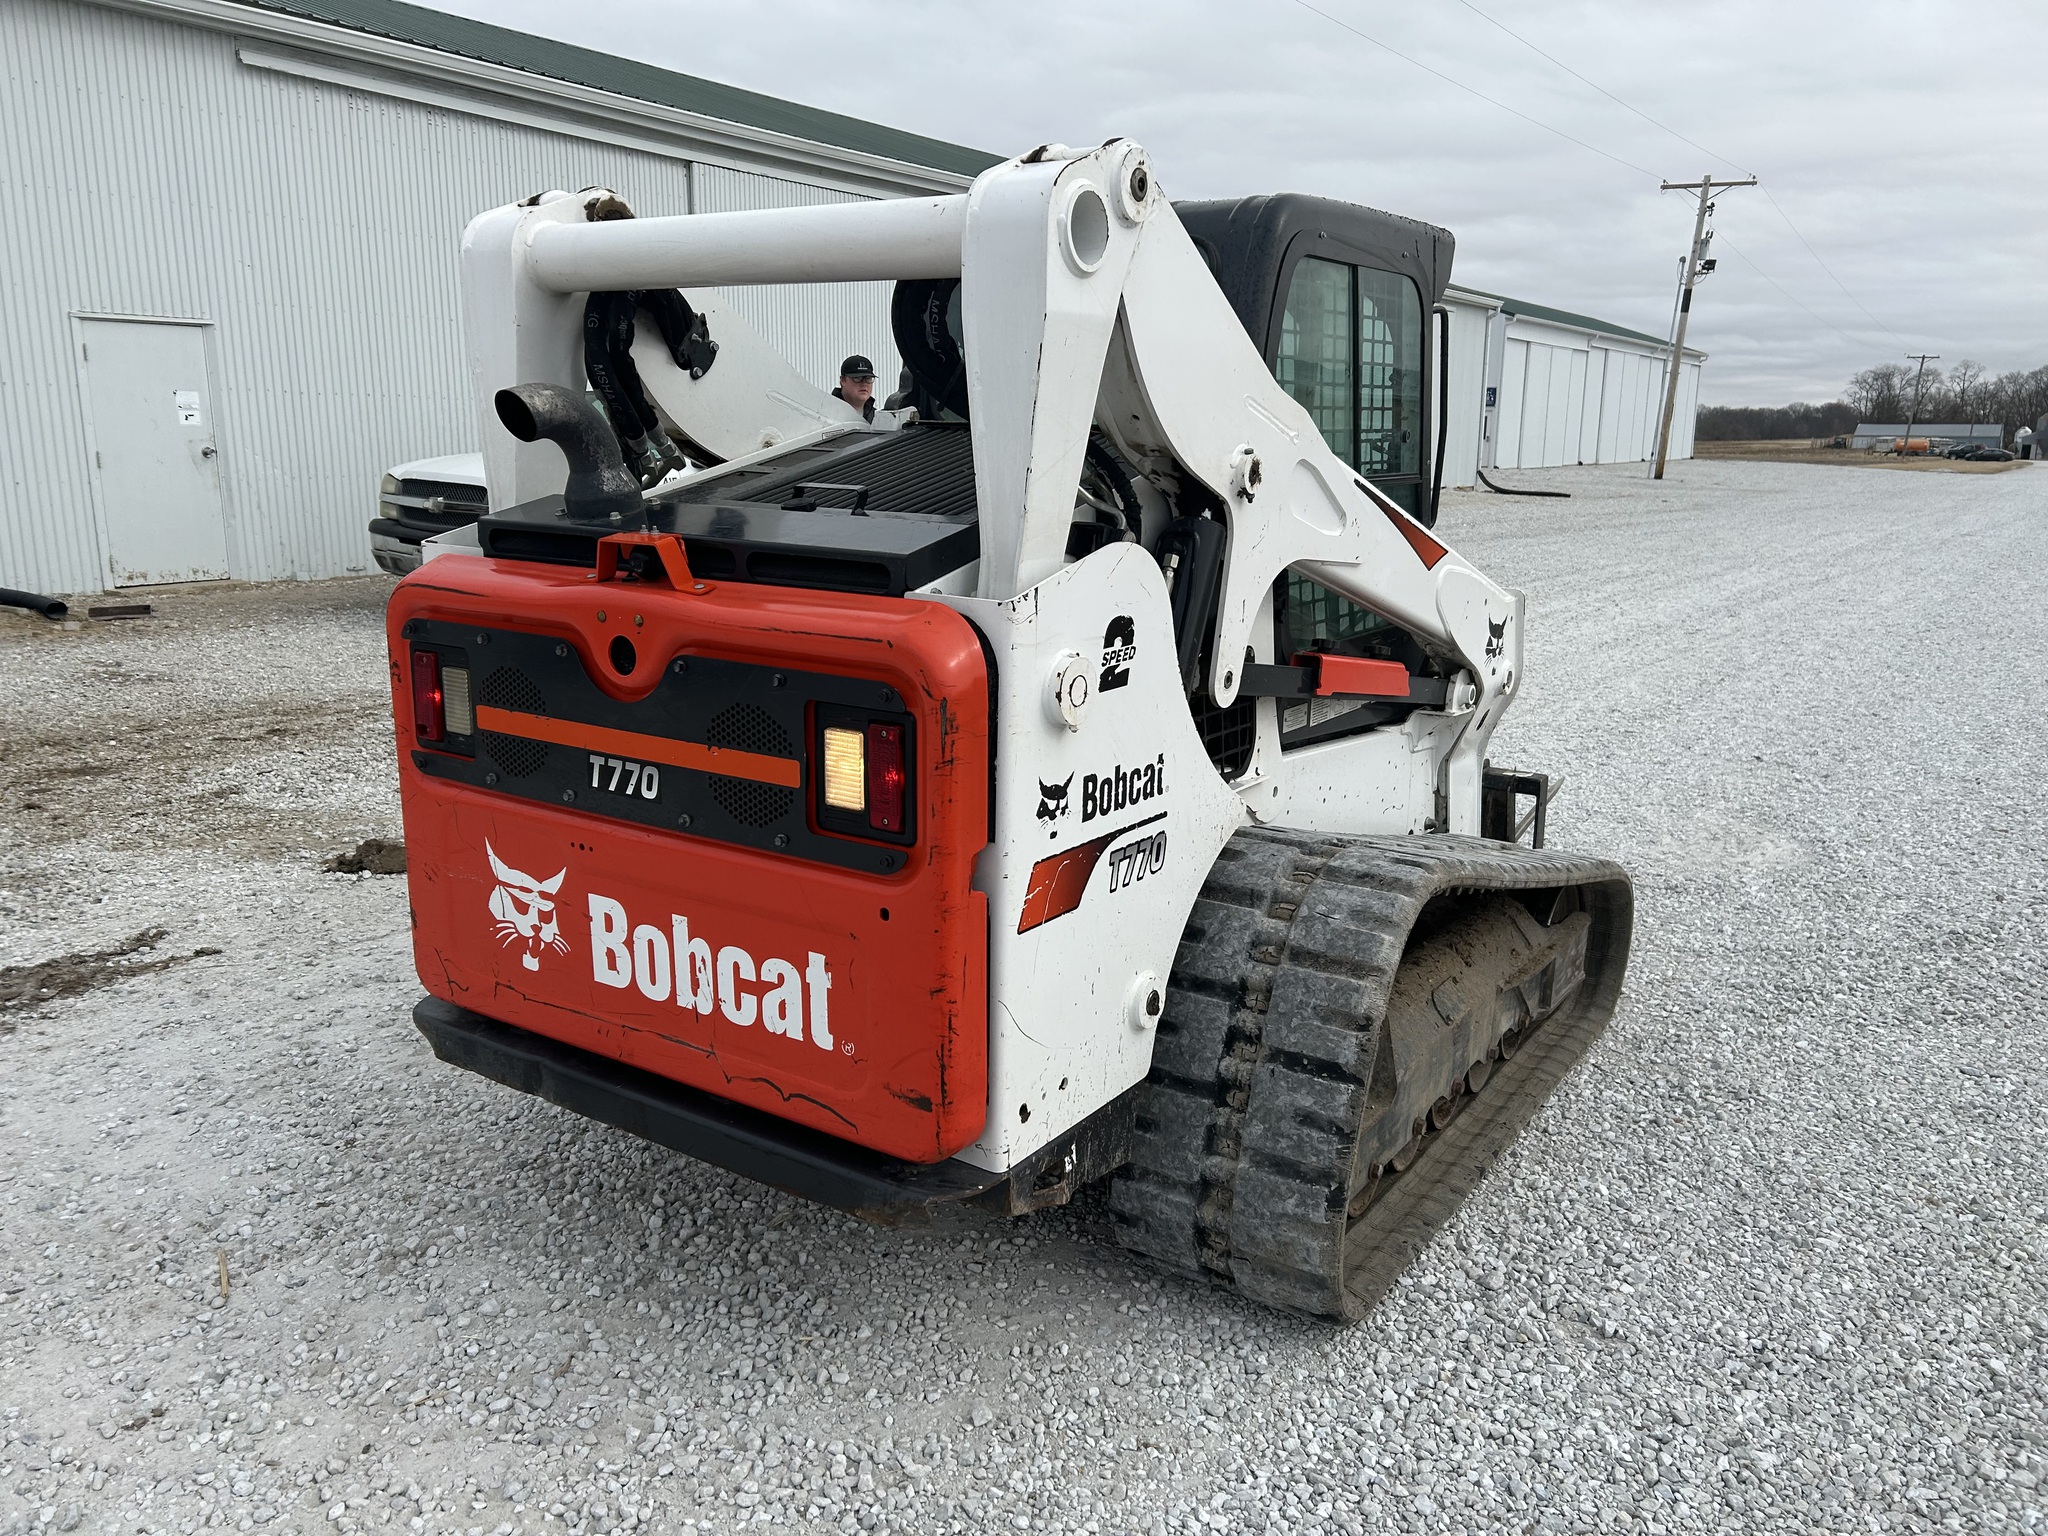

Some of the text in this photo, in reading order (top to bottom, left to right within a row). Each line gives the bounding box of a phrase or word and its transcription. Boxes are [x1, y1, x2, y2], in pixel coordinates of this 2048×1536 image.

[593, 364, 616, 401] MSHA
[1101, 646, 1136, 667] SPEED
[589, 754, 659, 799] T770
[1082, 753, 1164, 823] Bobcat
[1109, 830, 1167, 893] T770
[588, 893, 833, 1051] Bobcat
